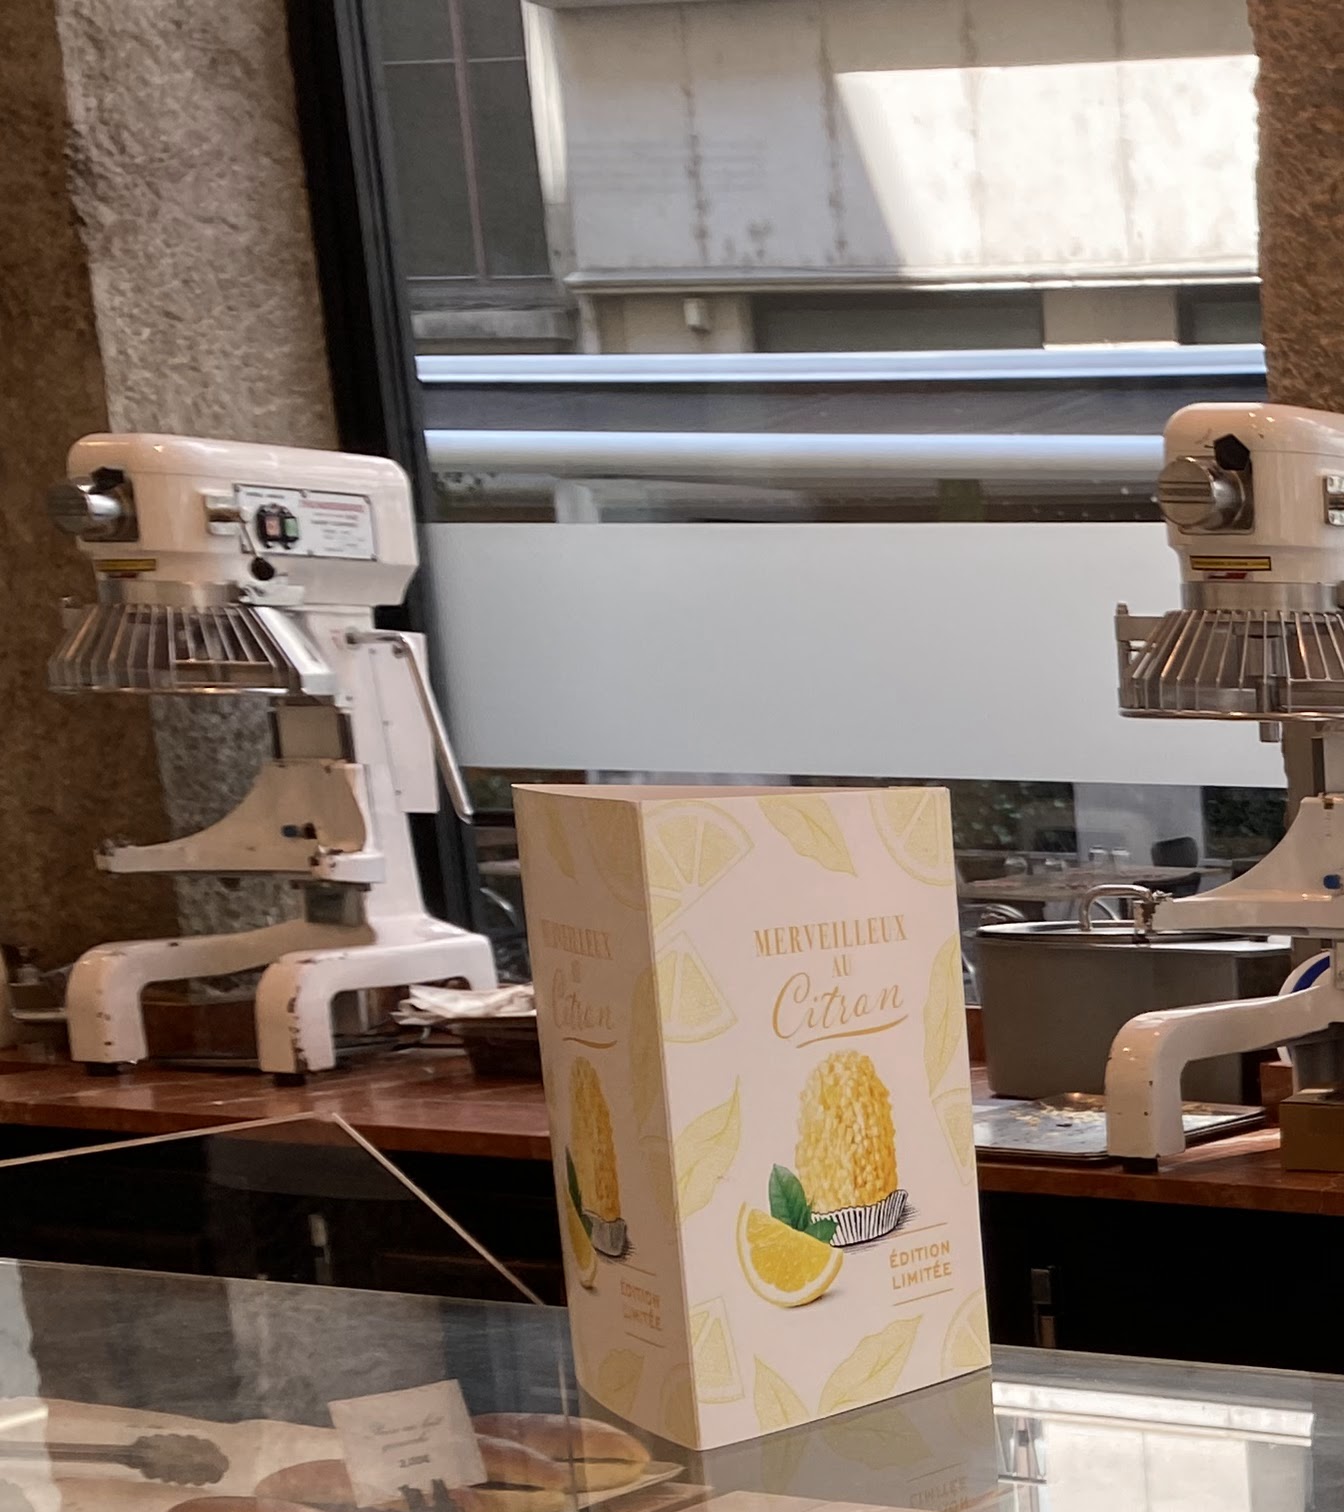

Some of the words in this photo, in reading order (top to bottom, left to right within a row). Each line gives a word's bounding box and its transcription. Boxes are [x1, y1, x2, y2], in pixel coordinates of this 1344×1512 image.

[754, 914, 908, 957] MERVEILLEUX
[832, 954, 853, 978] AU
[772, 972, 903, 1039] Citron
[889, 1240, 950, 1268] ÉDITION
[892, 1260, 952, 1290] LIMITÉE
